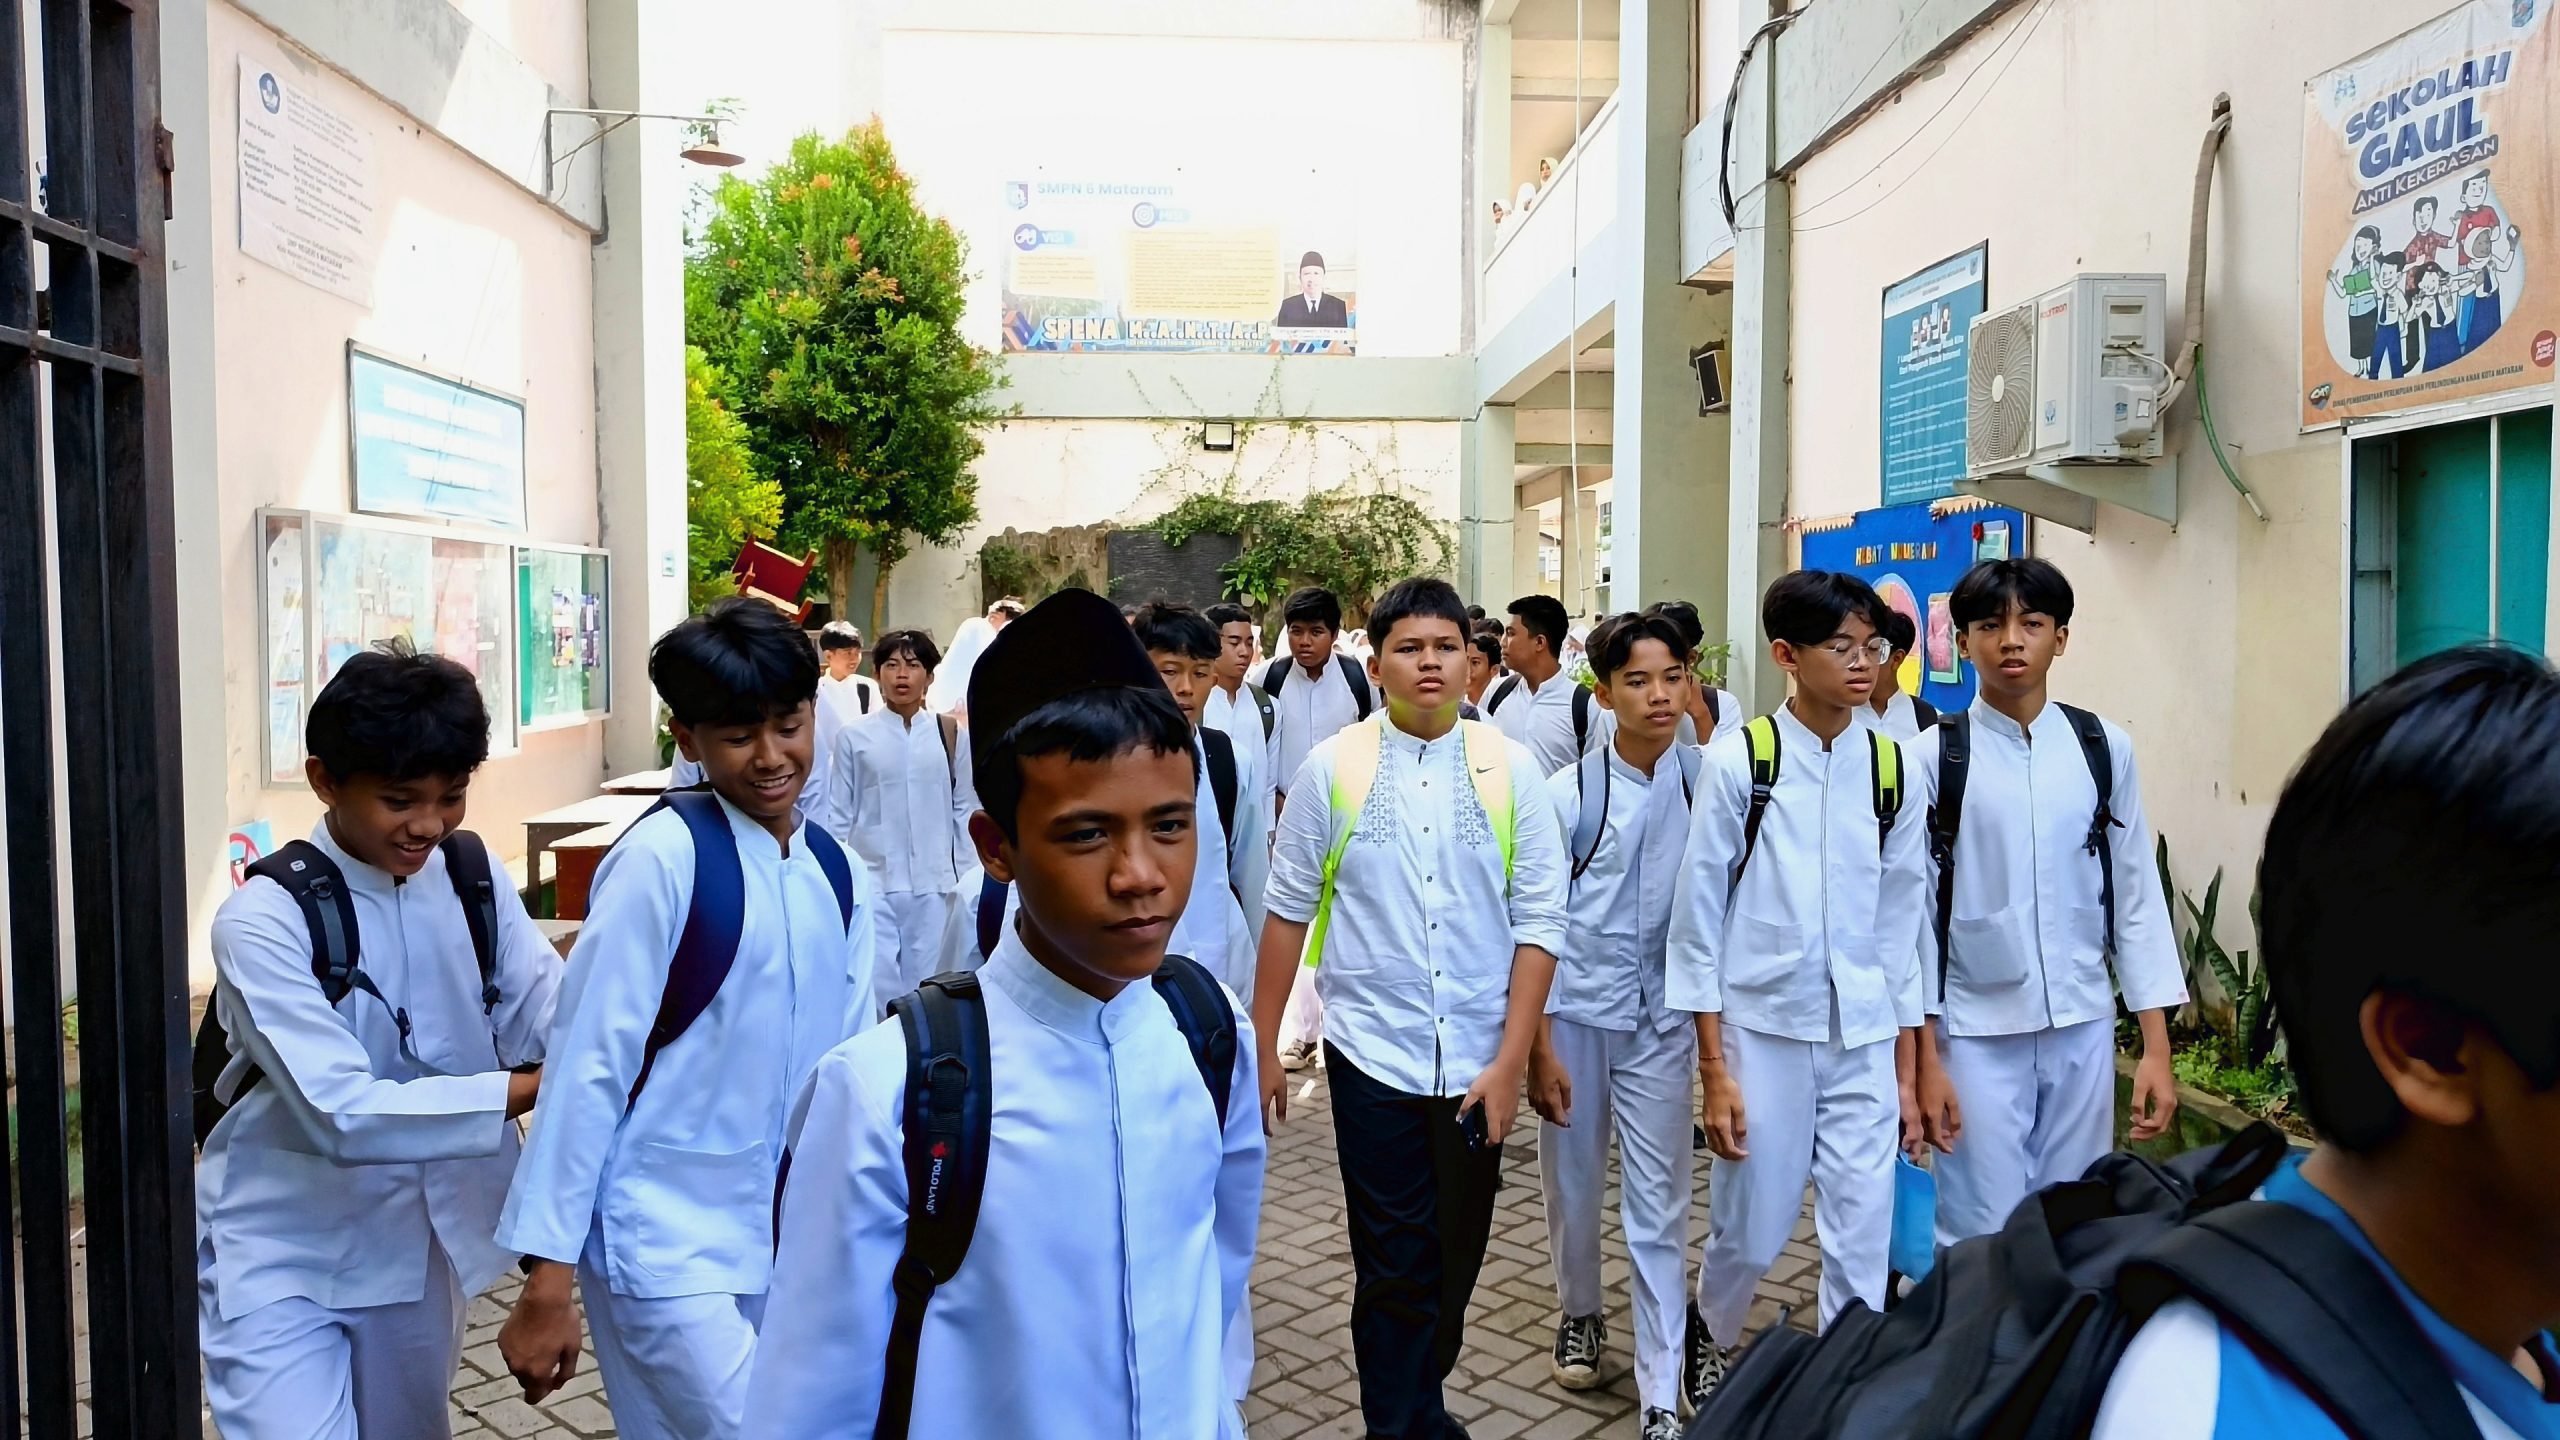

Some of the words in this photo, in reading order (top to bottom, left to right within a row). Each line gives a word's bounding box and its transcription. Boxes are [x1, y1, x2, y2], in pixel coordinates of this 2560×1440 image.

[2359, 96, 2483, 178] GAUL
[2355, 184, 2391, 211] ANTI
[2395, 138, 2495, 195] KEKERASAN
[1036, 181, 1082, 195] SMPN
[1085, 182, 1095, 195] 6
[1098, 182, 1174, 196] Mataram
[1042, 317, 1119, 340] SPENA
[2465, 373, 2480, 382] ANAK
[2481, 370, 2495, 379] KOTA
[2495, 365, 2524, 376] MATARAM
